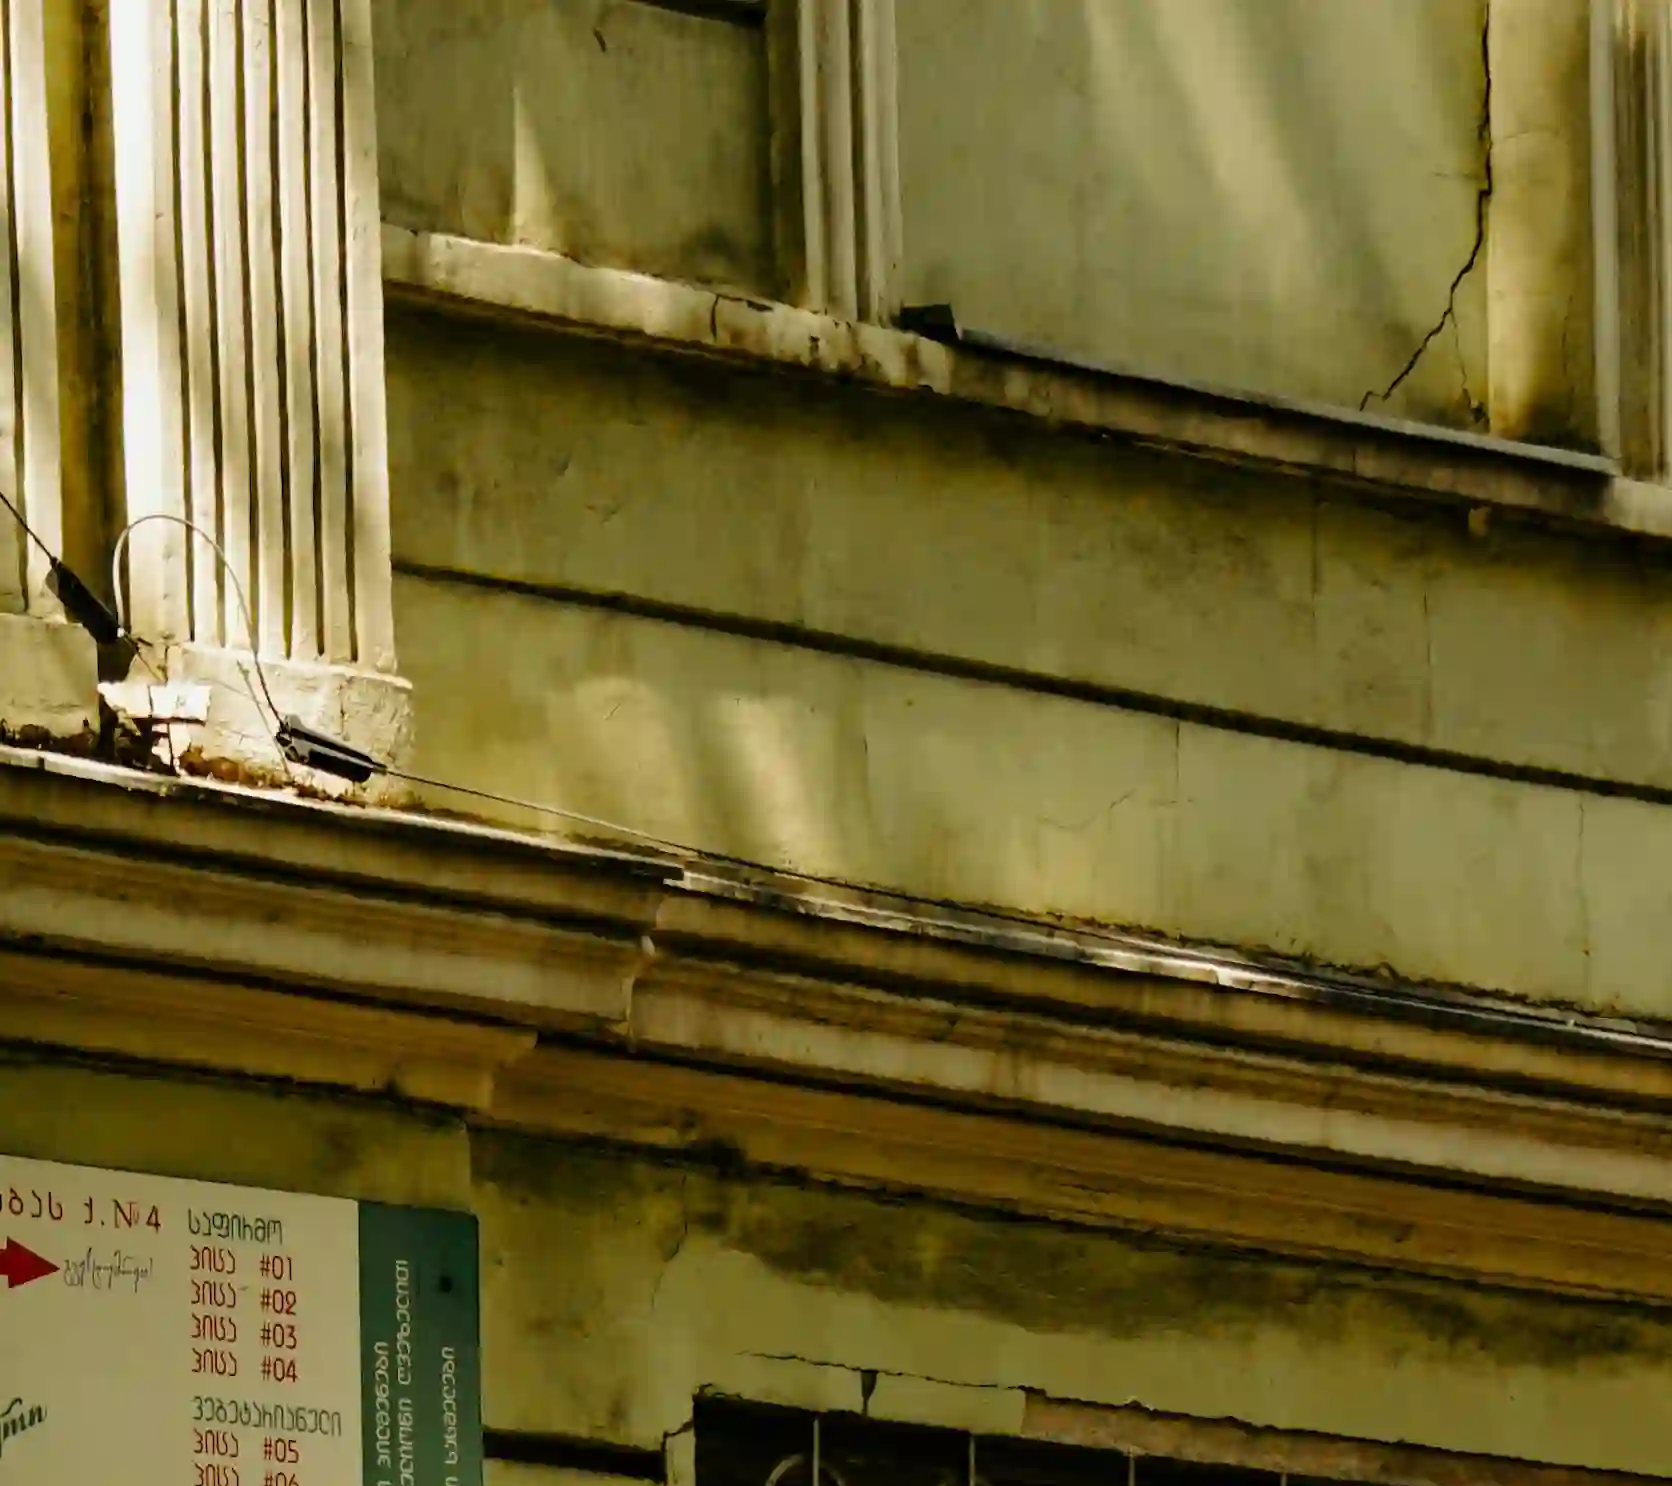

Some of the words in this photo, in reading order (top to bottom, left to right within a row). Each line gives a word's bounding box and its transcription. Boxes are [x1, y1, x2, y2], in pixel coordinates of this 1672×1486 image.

[0, 1186, 63, 1222] ბას
[187, 1207, 283, 1245] საფირმო
[189, 1245, 236, 1275] პიცა
[259, 1252, 293, 1281] #01
[190, 1279, 237, 1309] პიცა
[259, 1287, 297, 1316] #02
[191, 1313, 237, 1343] პიცა
[260, 1322, 298, 1349] #03
[191, 1347, 238, 1377] პიცა
[261, 1356, 298, 1383] #04
[193, 1428, 240, 1458] პიცა
[264, 1436, 300, 1464] #05
